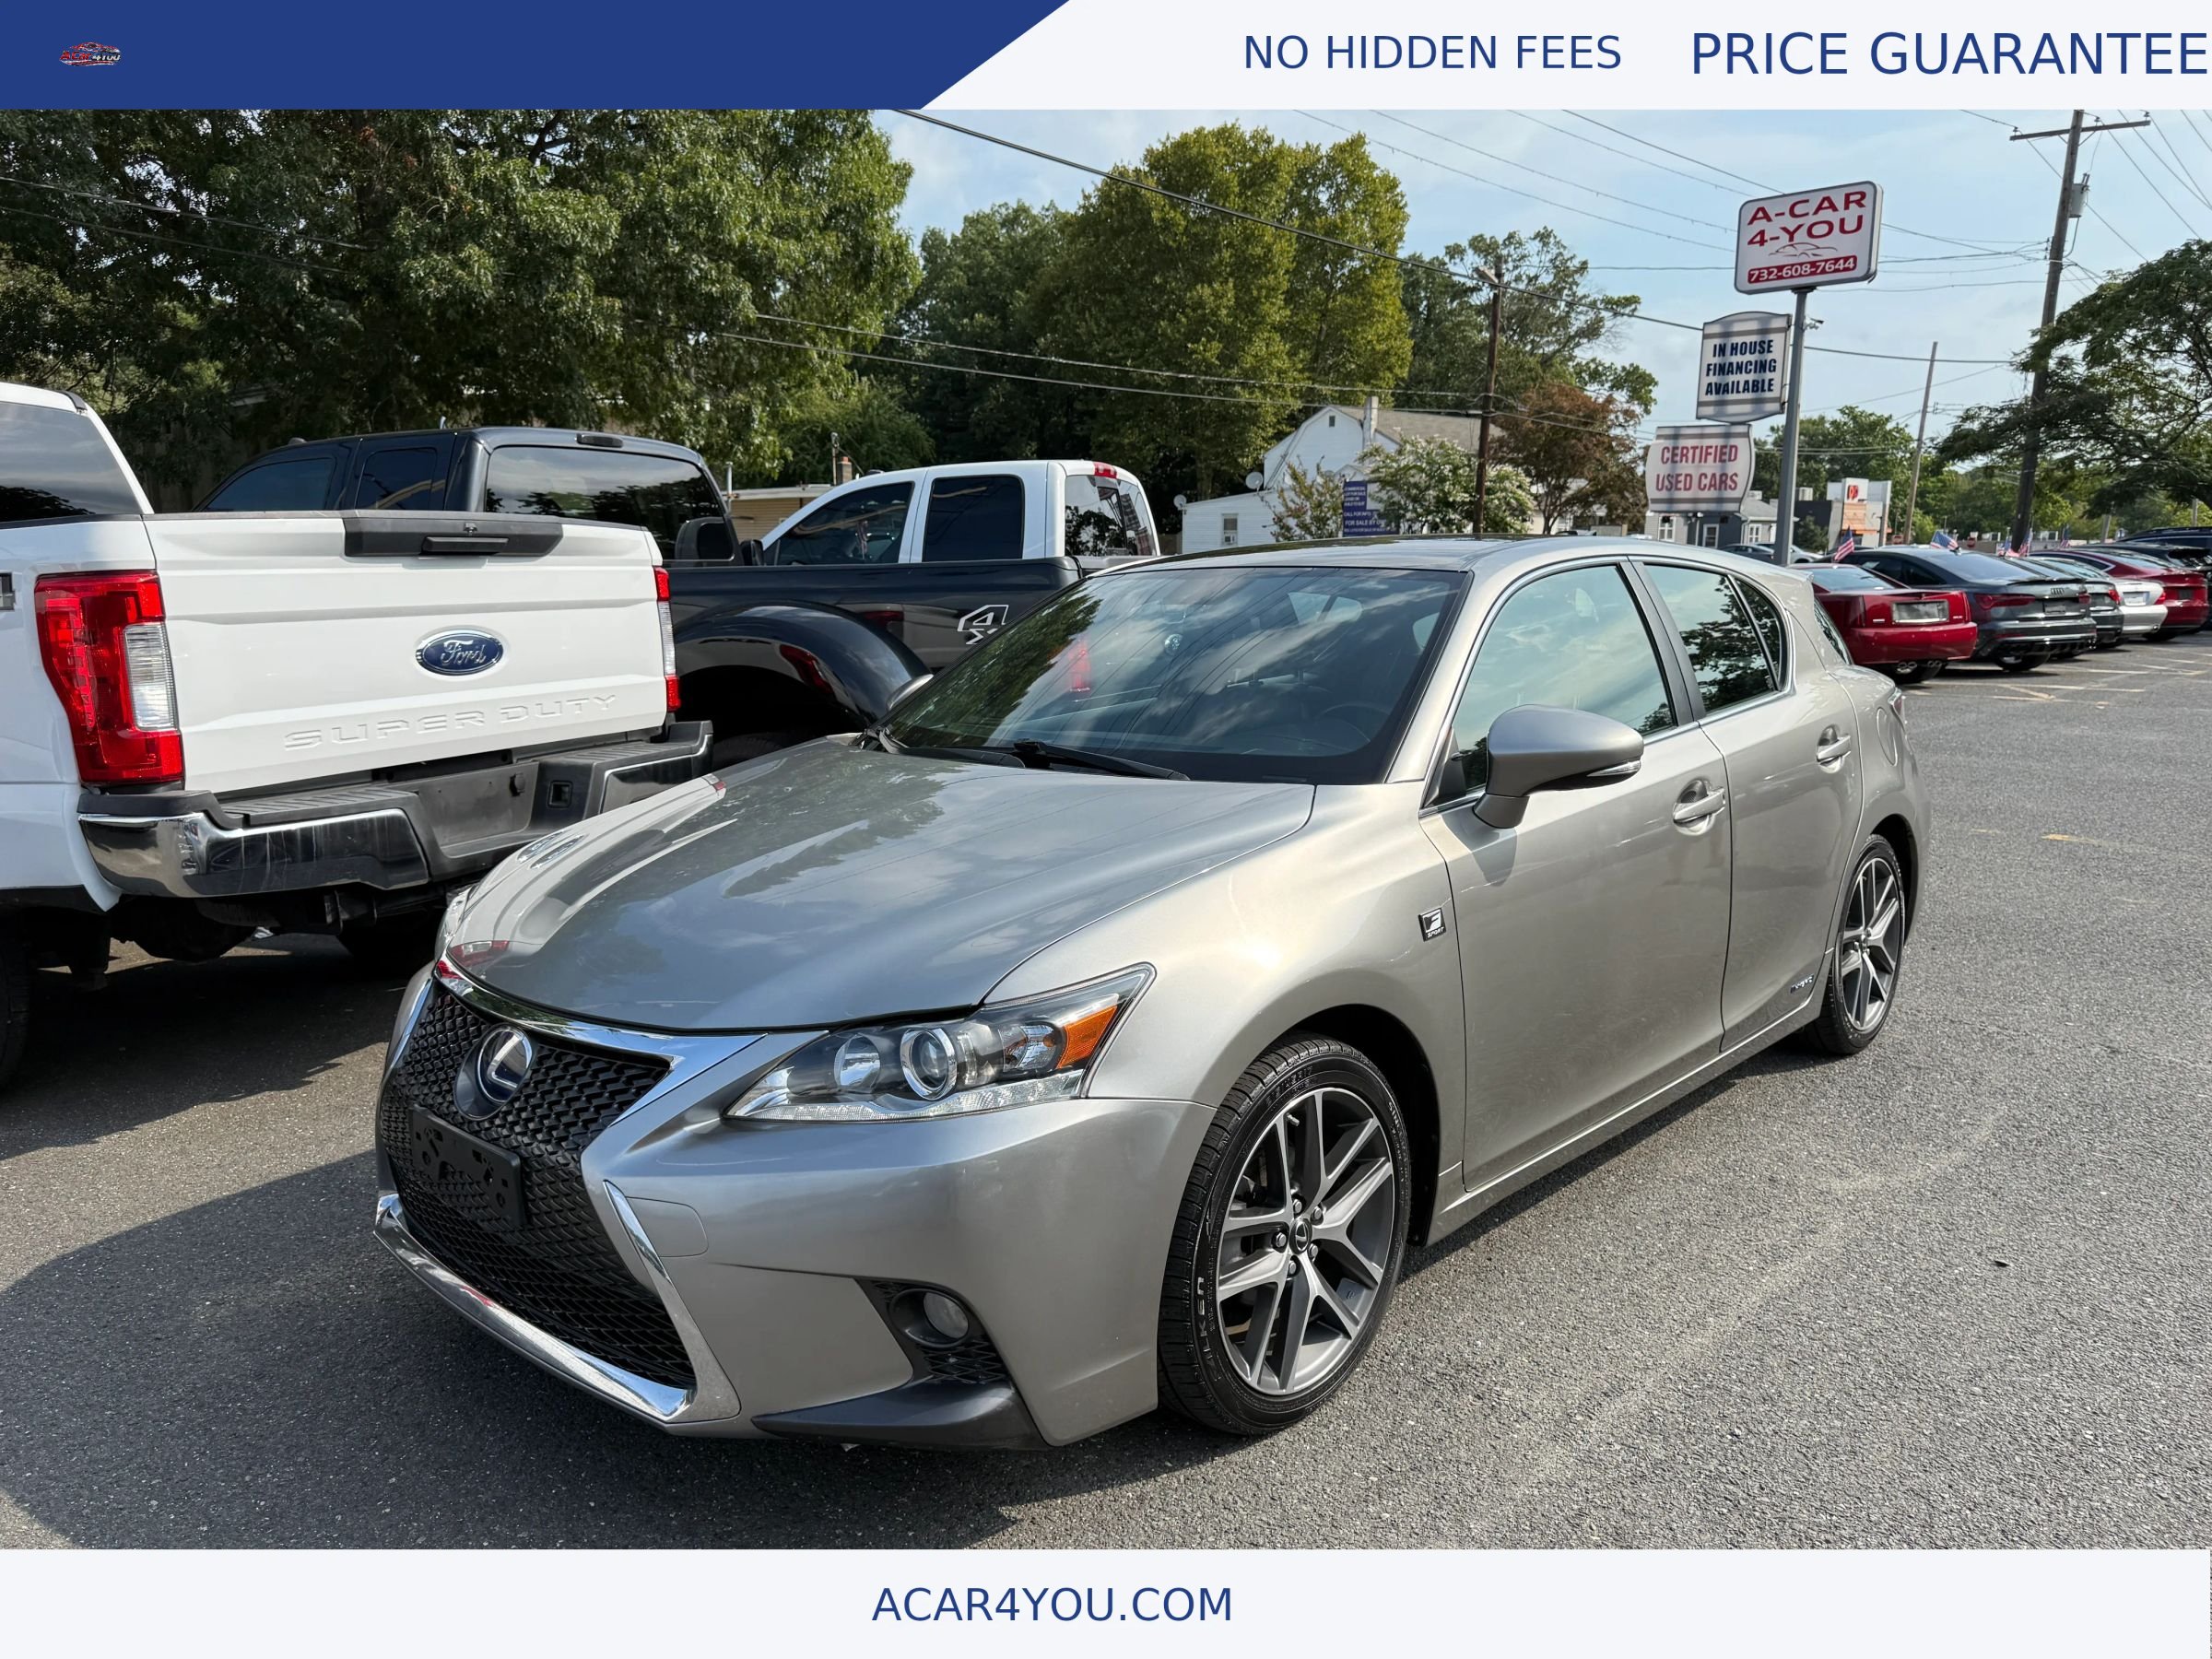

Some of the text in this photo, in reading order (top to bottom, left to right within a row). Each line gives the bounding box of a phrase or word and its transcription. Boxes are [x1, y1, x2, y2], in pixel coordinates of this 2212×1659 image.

[1747, 191, 1866, 226] A-CAR
[1747, 215, 1864, 247] 4-YOU
[1750, 257, 1855, 282] 732-608-7644
[1712, 339, 1773, 358] IN HOUSE
[1705, 359, 1777, 377] FINANCING
[1705, 378, 1774, 396] AVAILABLE
[1661, 444, 1738, 465] CERTIFIED
[1655, 472, 1738, 492] USED CARS
[441, 640, 487, 665] Ford
[284, 694, 617, 752] SUPER DUTY
